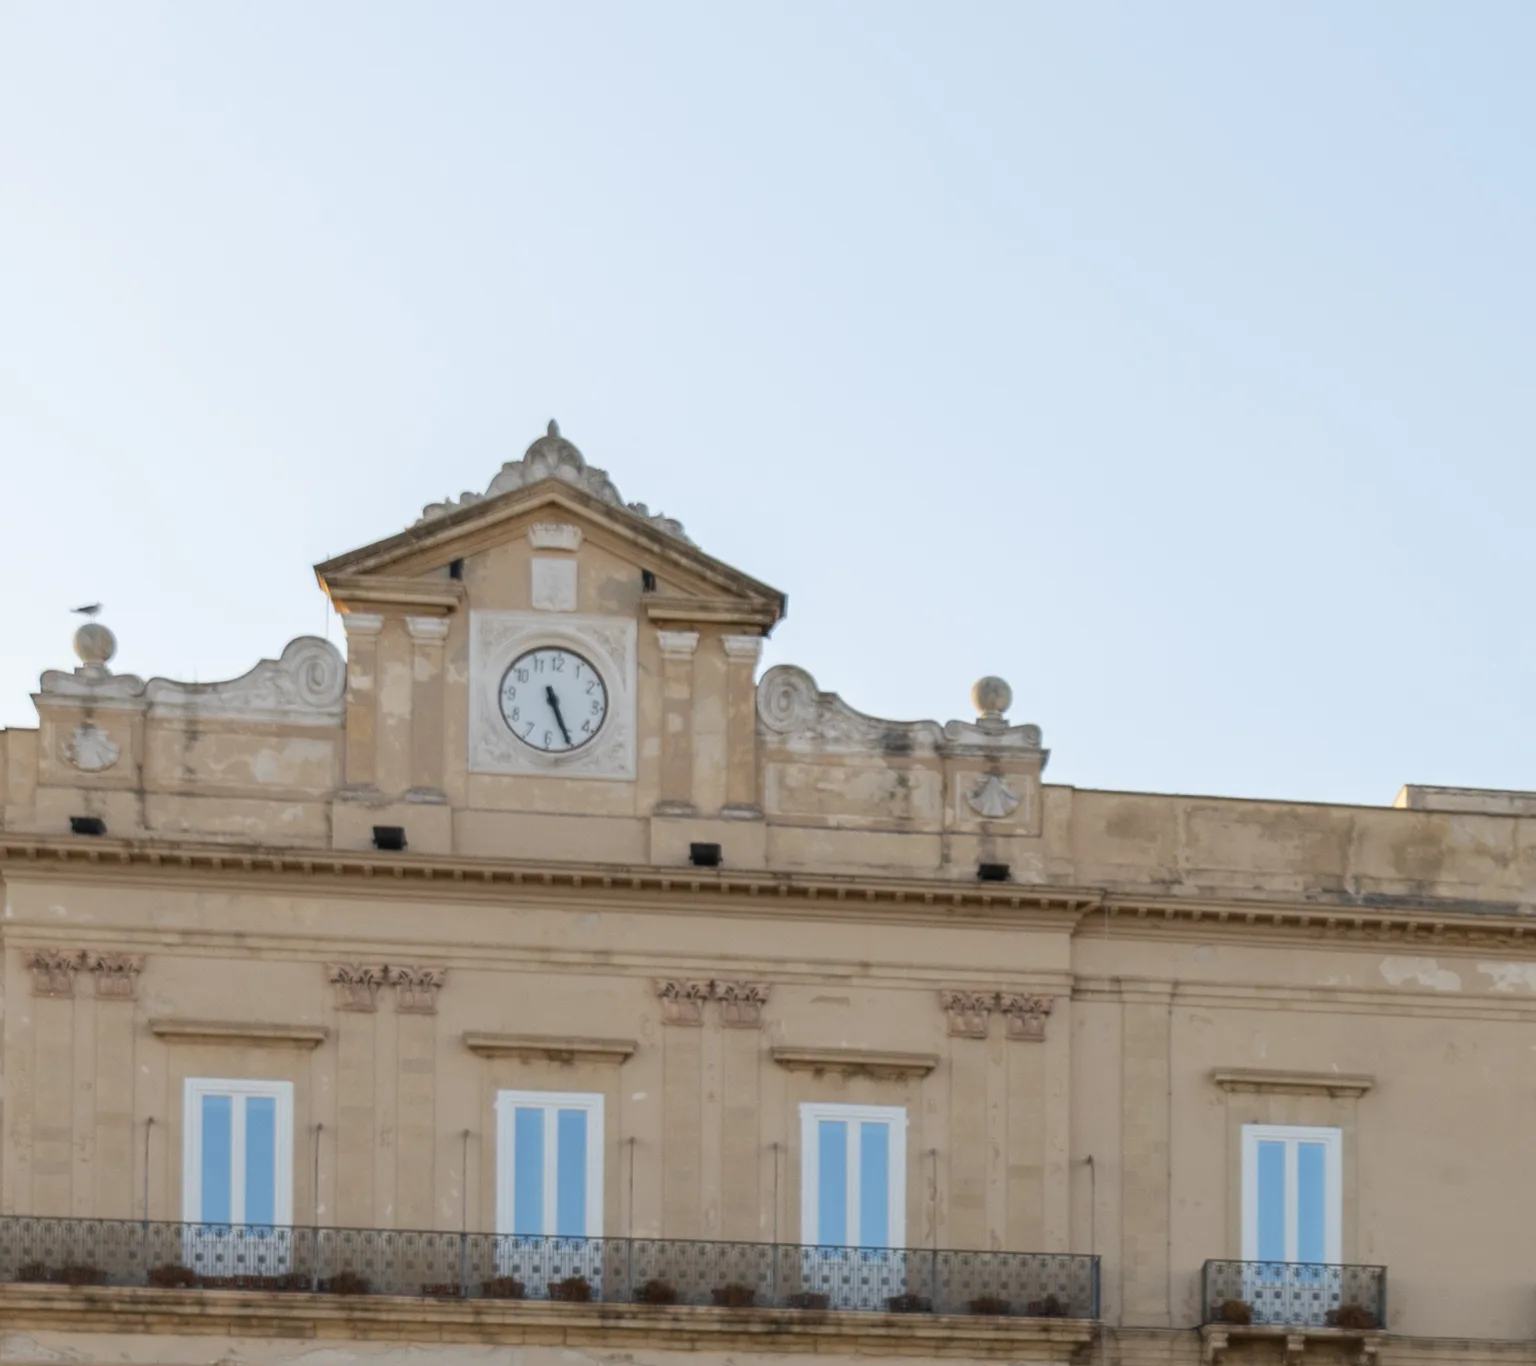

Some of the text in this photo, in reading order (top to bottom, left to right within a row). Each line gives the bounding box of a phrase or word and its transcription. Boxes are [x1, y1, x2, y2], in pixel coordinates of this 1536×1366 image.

[534, 657, 544, 674] 11
[552, 657, 565, 673] 12
[516, 668, 530, 683] 10
[507, 686, 516, 701] 9
[586, 681, 595, 695] 2
[512, 707, 520, 722] 8
[591, 700, 600, 715] 3
[526, 722, 535, 736] 7
[581, 720, 590, 733] 4
[545, 730, 553, 746] 6
